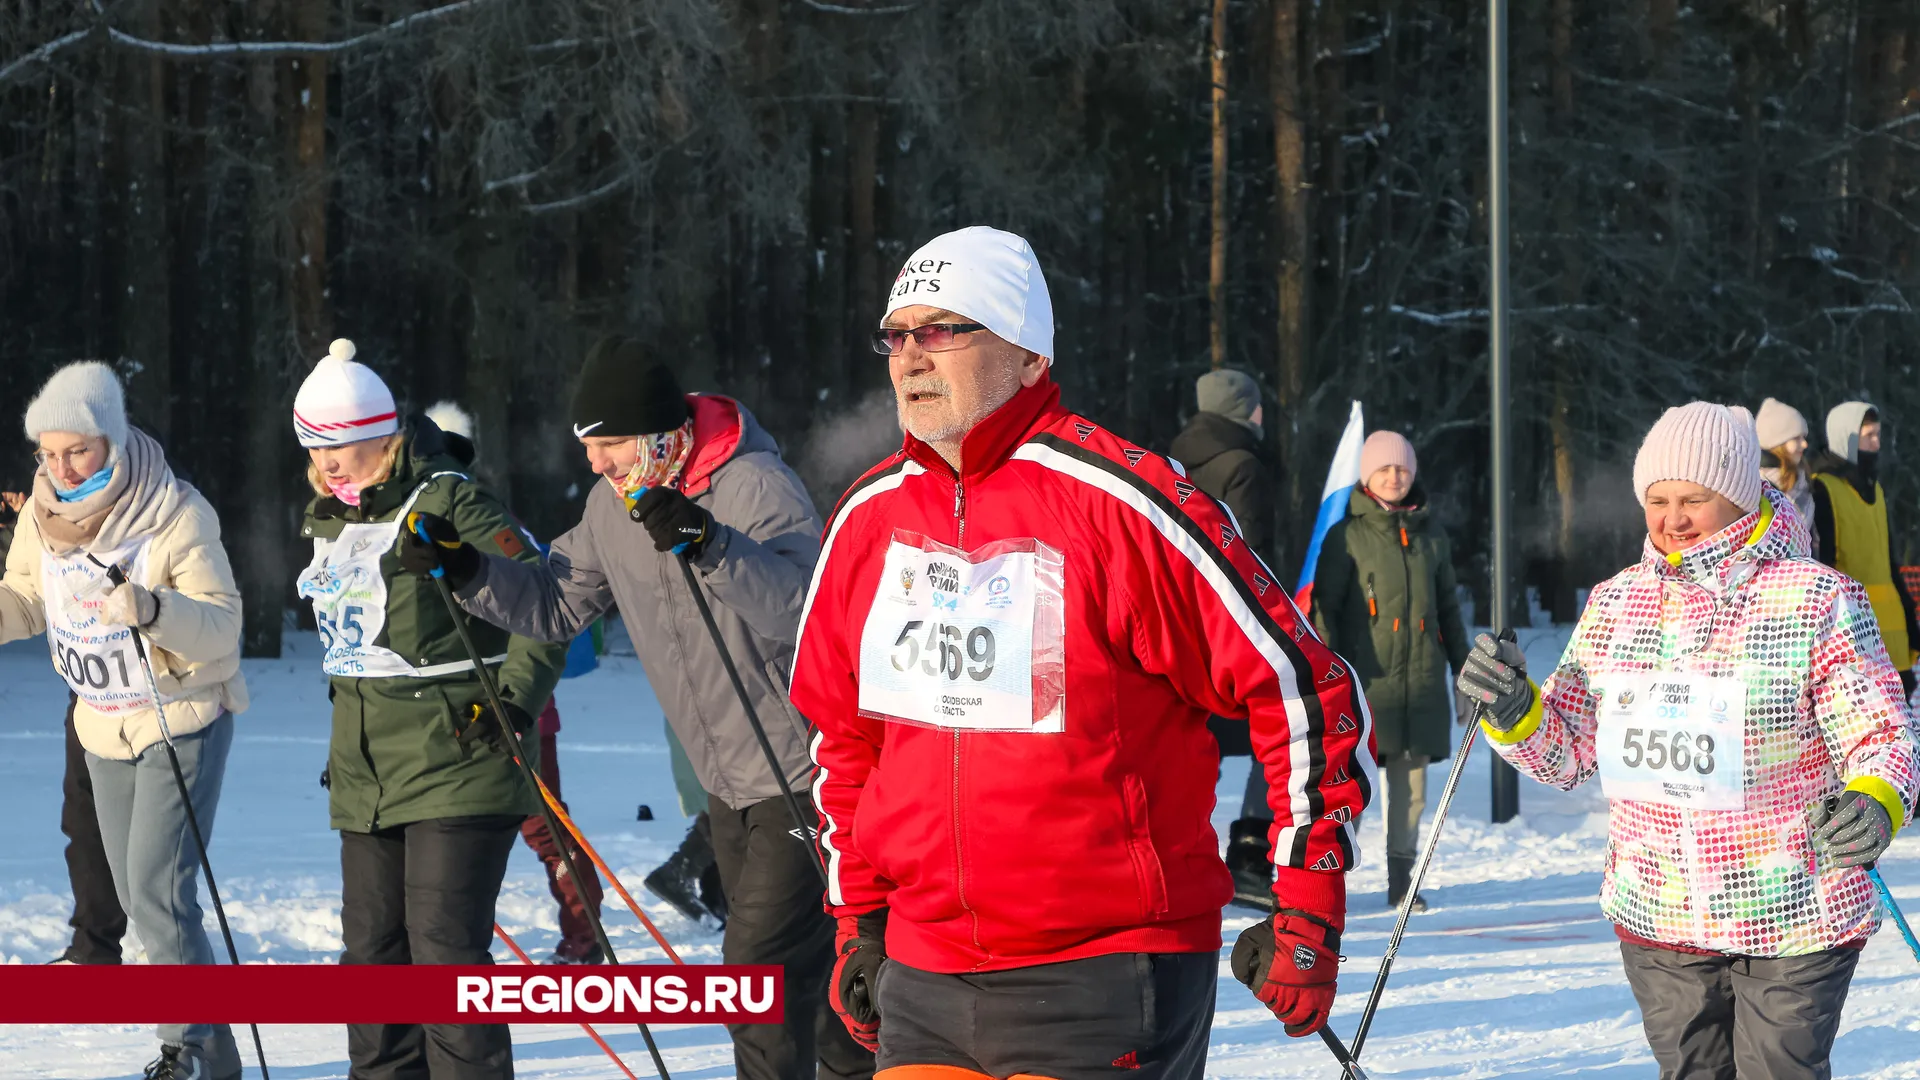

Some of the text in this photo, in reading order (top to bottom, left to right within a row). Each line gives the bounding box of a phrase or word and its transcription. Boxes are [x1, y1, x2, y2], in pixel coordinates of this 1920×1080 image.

[57, 636, 131, 690] 5001
[890, 620, 996, 682] 5569
[1622, 728, 1715, 775] 5568
